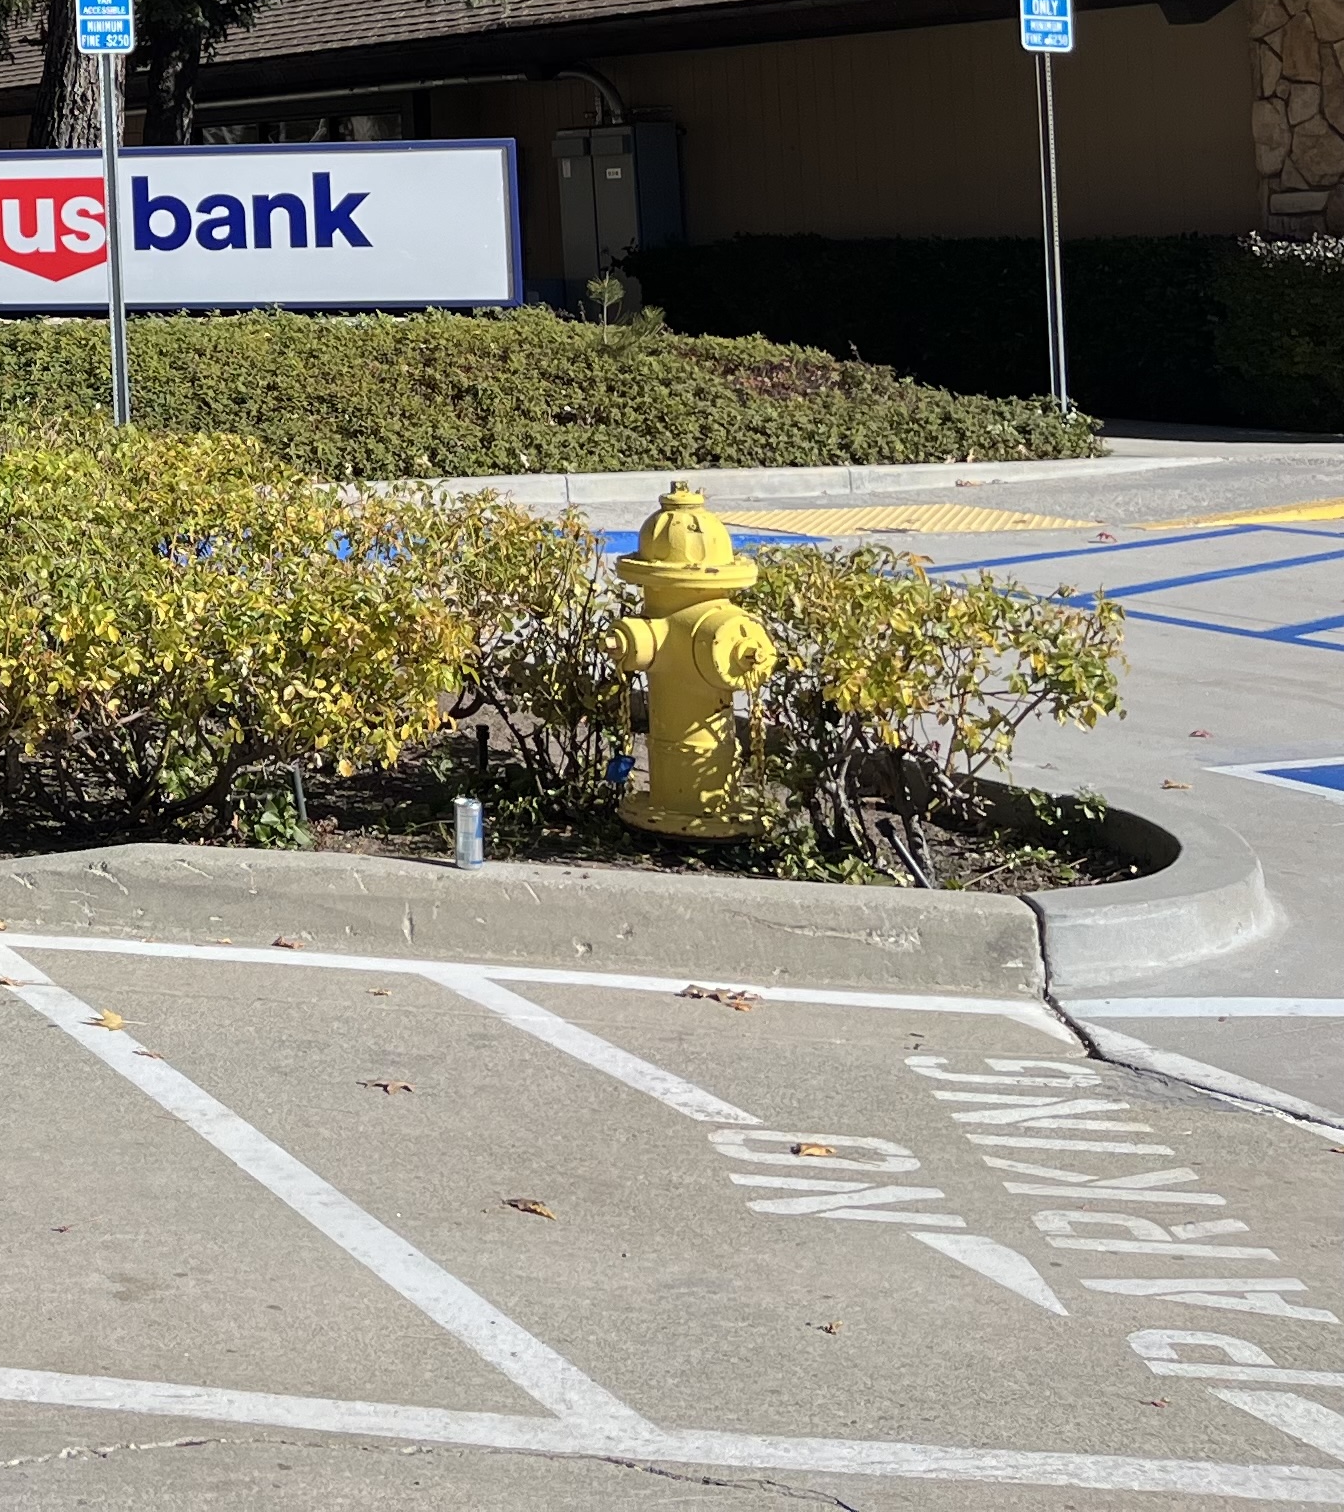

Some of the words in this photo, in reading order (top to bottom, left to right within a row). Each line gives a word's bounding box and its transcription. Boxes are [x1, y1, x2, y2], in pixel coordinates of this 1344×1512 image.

[83, 6, 126, 15] ACCESSIBLE
[1032, 0, 1058, 16] ONLY
[87, 20, 123, 32] MINIMUM
[82, 34, 100, 47] FINE
[105, 34, 129, 47] $250
[1, 196, 106, 254] us
[131, 171, 373, 251] bank
[708, 1129, 968, 1228] NO
[904, 1055, 1344, 1386] PARKING
